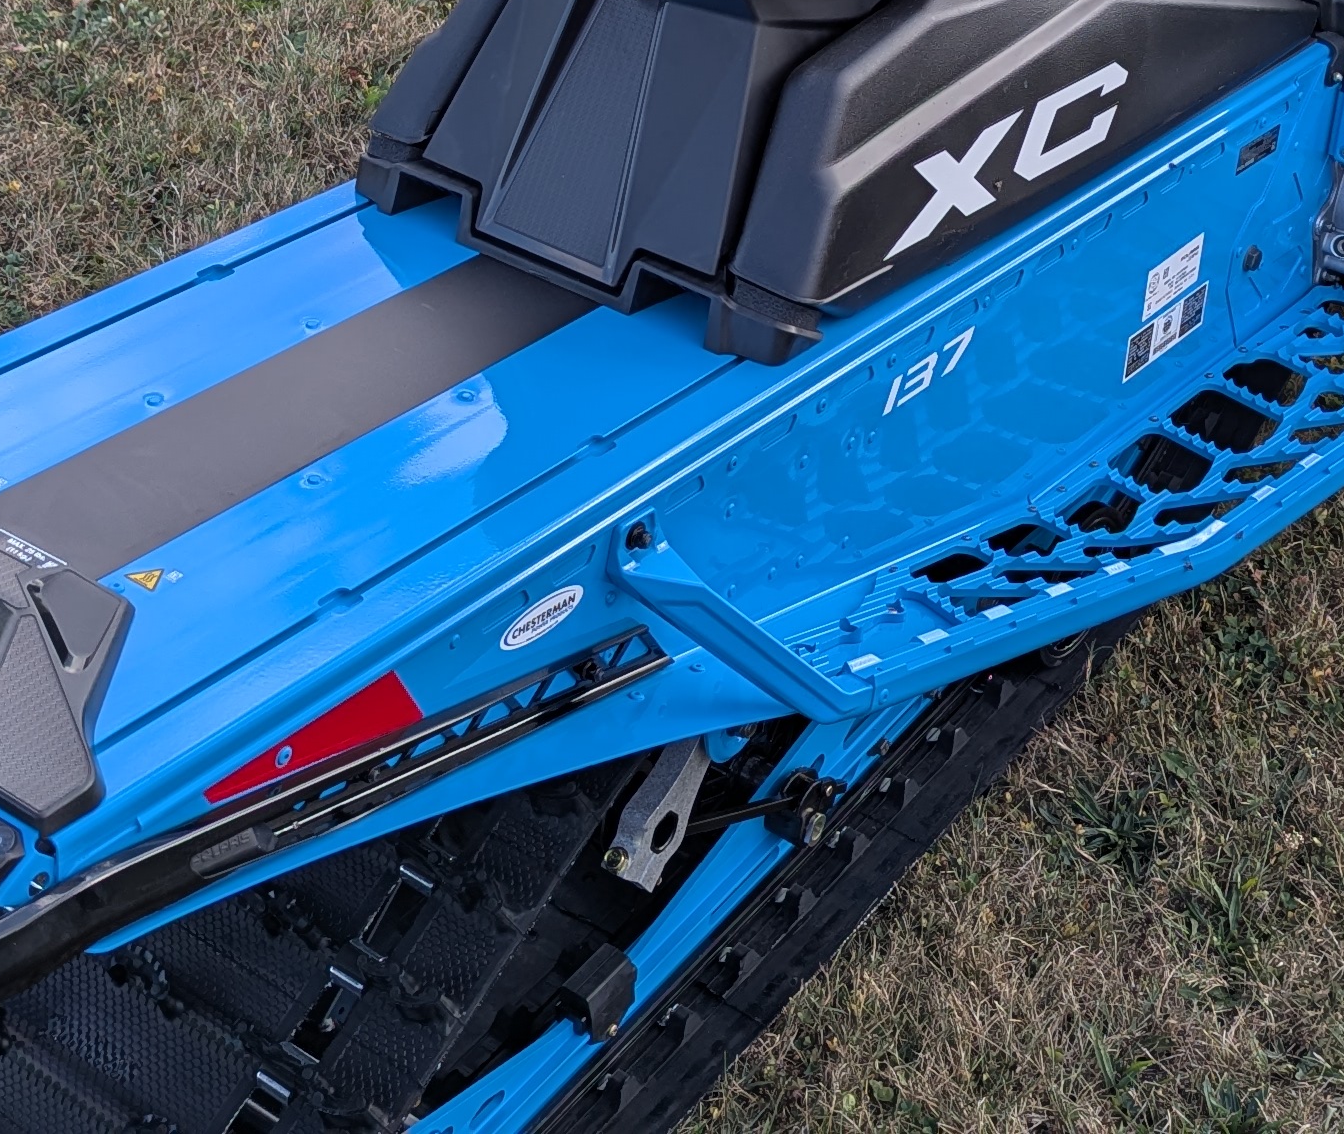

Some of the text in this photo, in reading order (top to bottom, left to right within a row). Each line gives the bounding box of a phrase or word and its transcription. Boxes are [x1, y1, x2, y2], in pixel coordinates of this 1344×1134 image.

[882, 61, 1129, 262] XC
[881, 325, 976, 417] 137
[511, 592, 577, 640] CHESTERMAN
